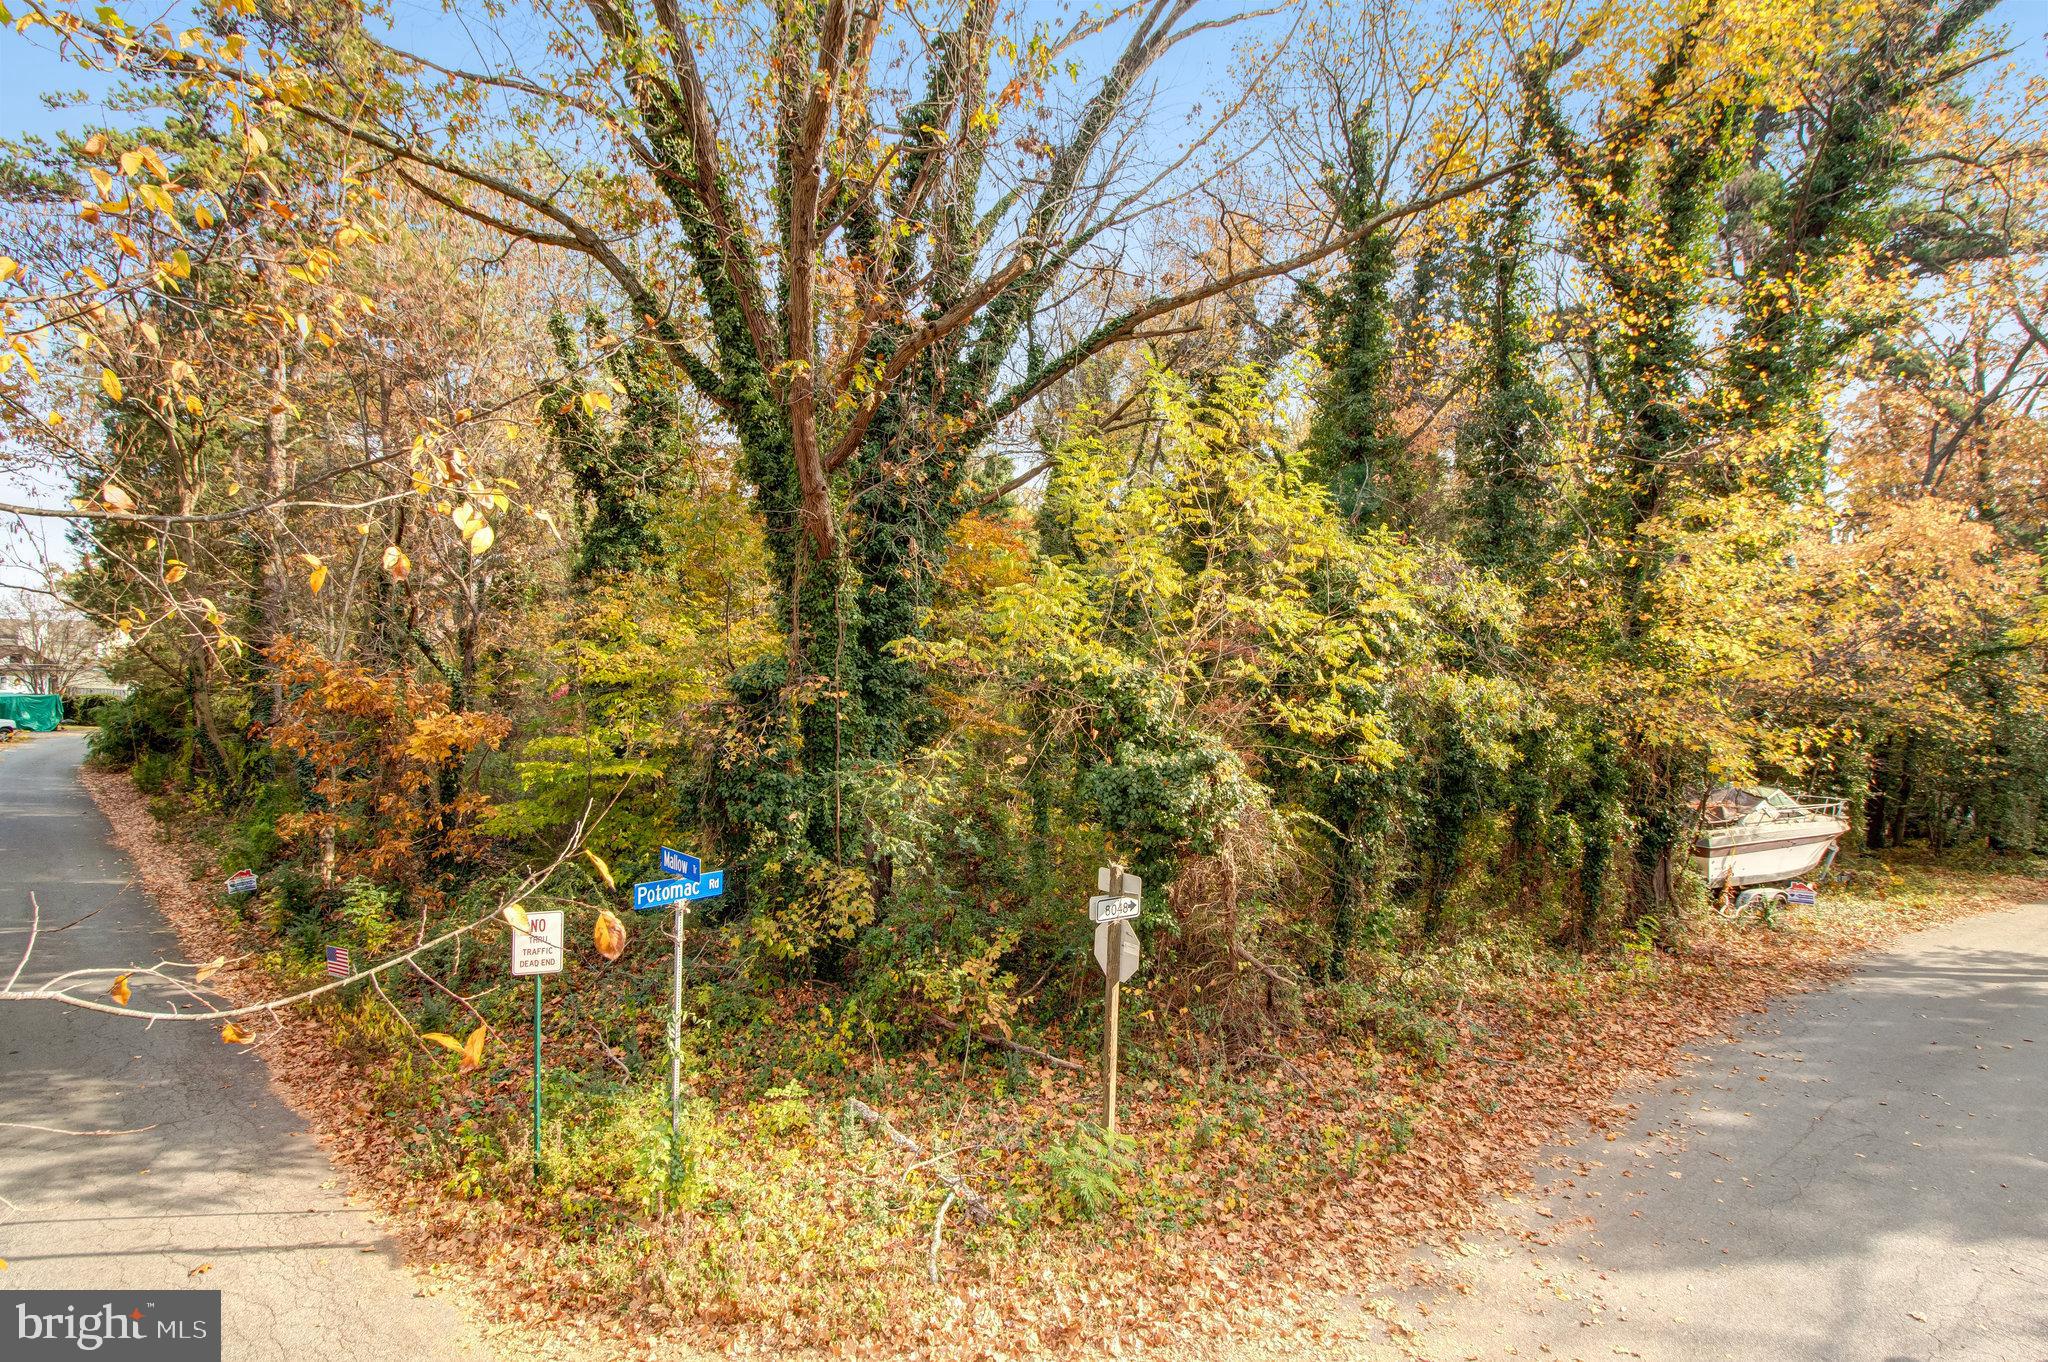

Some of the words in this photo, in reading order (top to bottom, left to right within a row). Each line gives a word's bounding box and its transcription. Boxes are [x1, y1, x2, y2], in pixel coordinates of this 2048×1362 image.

[664, 850, 689, 874] Mallow
[637, 881, 701, 905] Potomac
[708, 878, 720, 889] Rd
[1104, 902, 1129, 916] 8048
[530, 918, 546, 932] NO
[522, 947, 553, 956] TRAFFIC
[520, 960, 540, 968] DEAD
